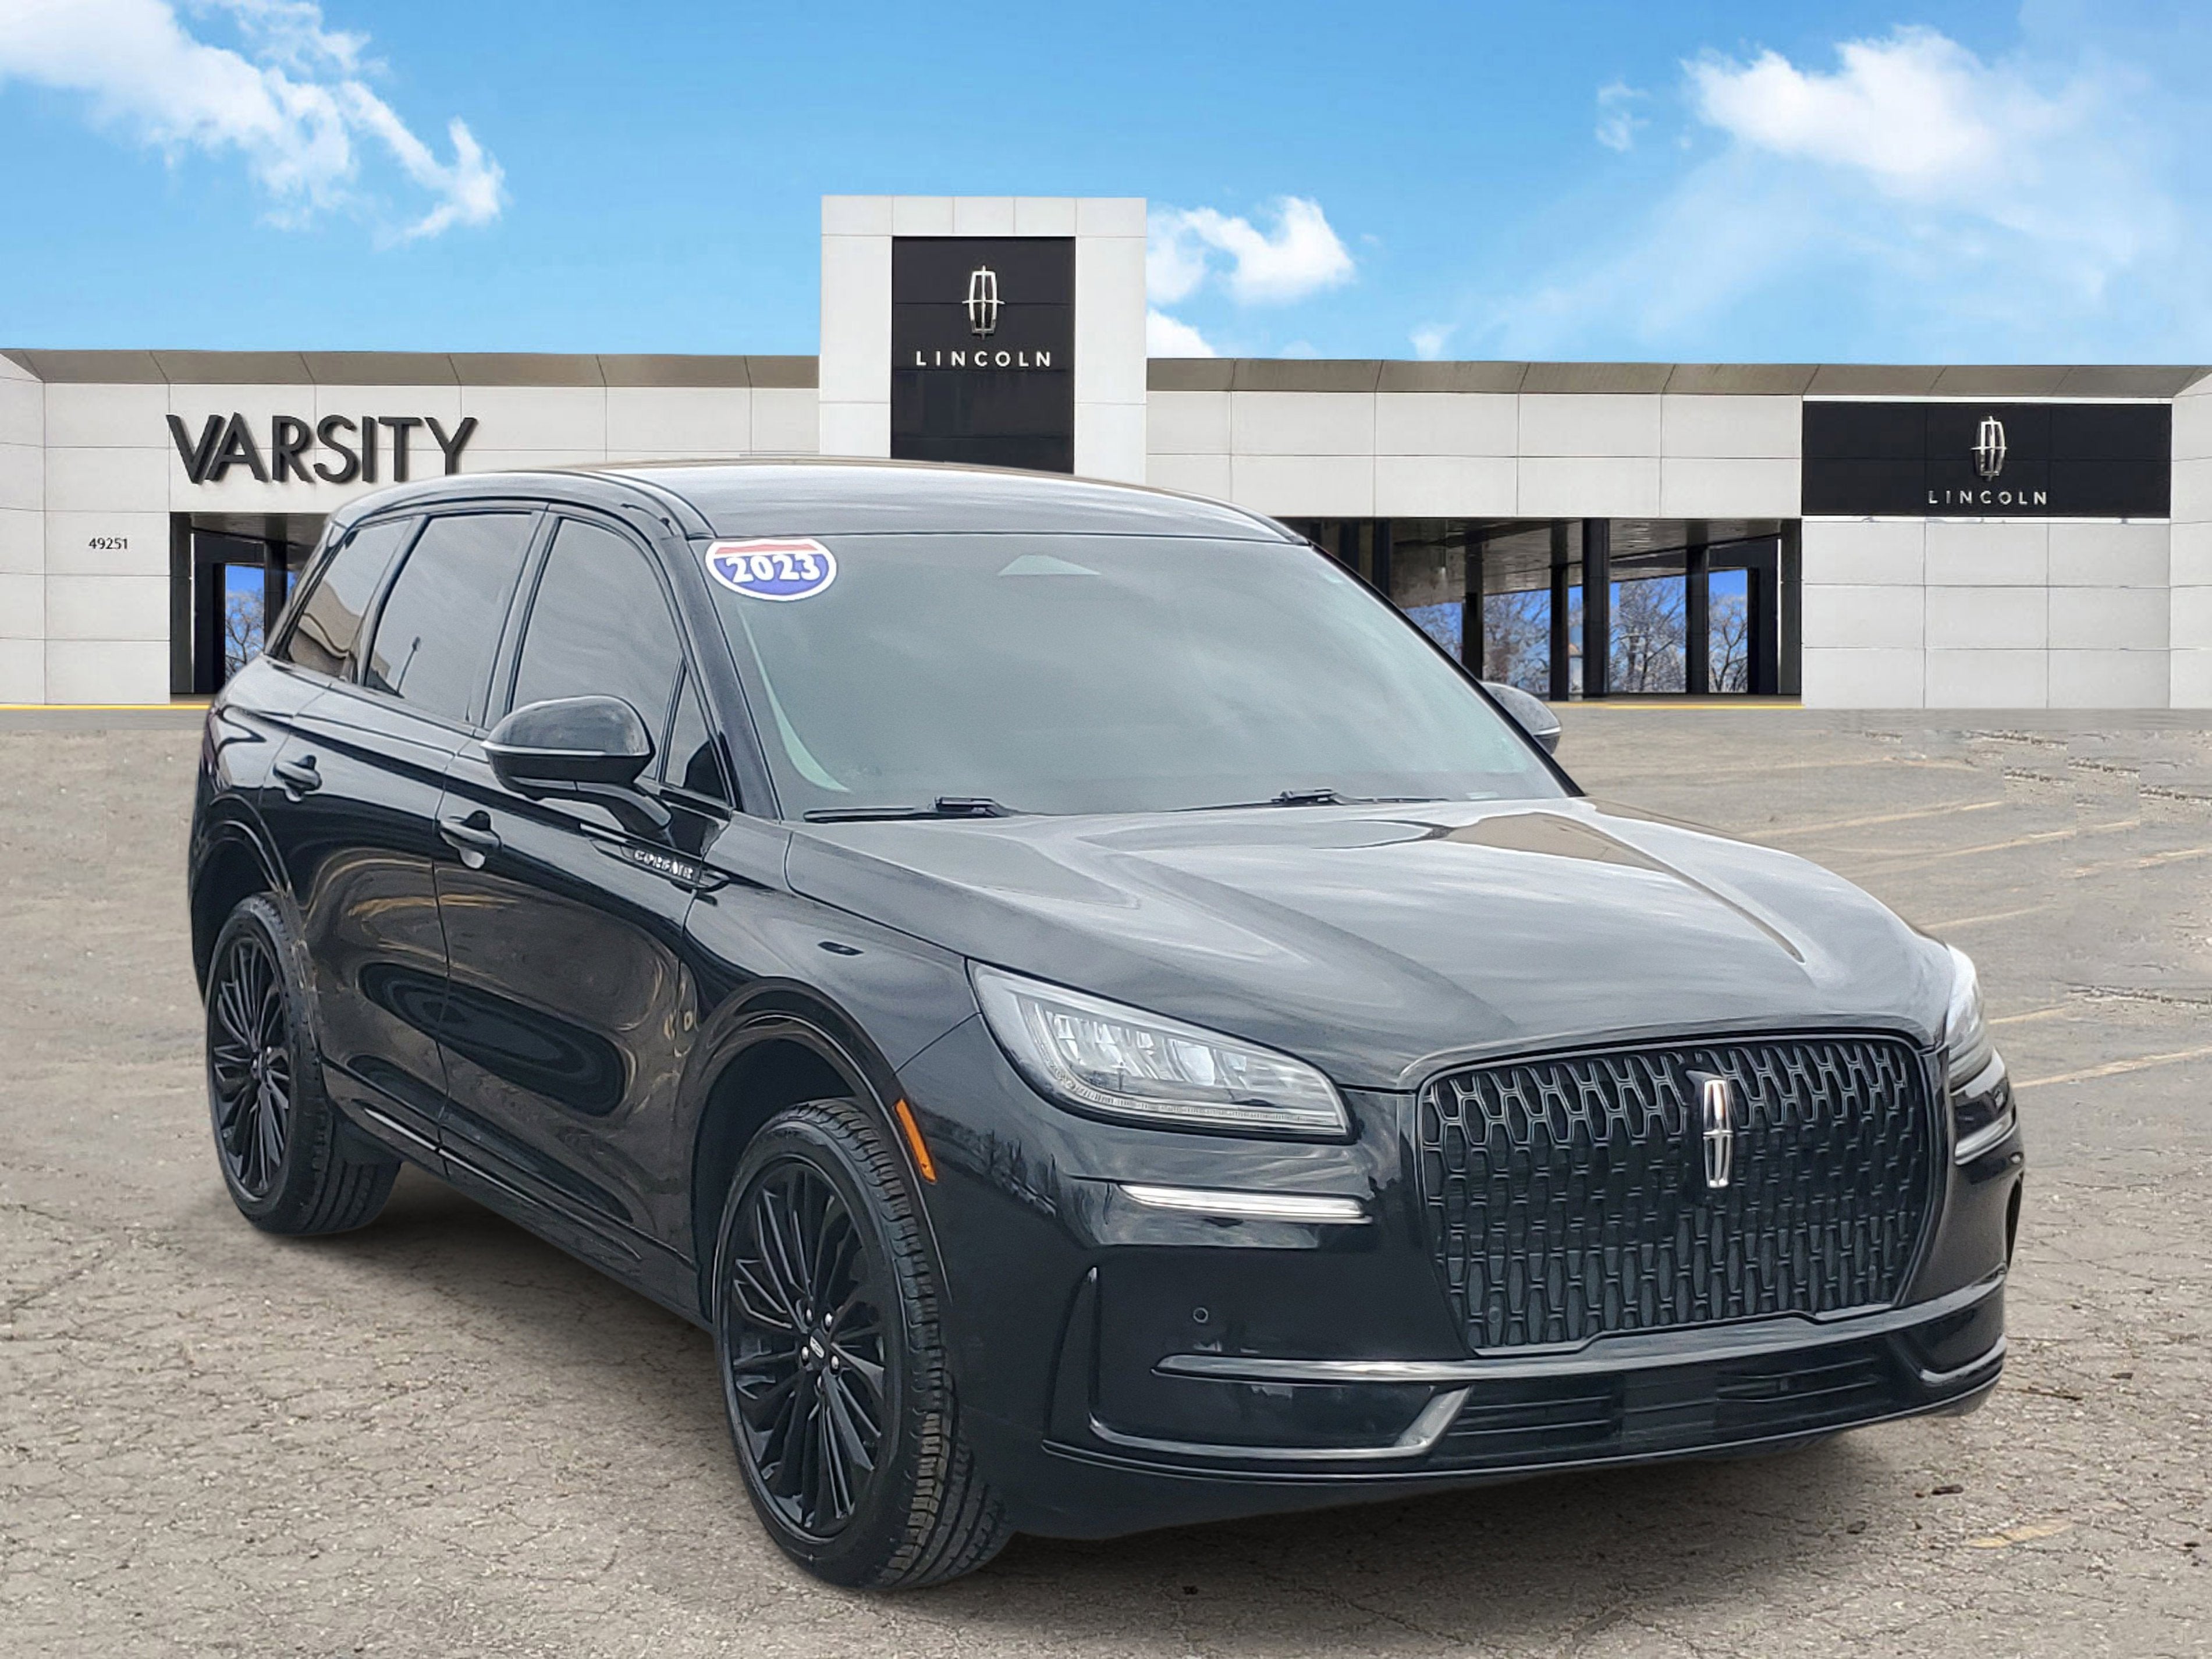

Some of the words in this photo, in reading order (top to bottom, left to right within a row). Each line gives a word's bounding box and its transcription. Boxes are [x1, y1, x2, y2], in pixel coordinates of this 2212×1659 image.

[915, 351, 1051, 367] LINCOLN
[165, 412, 478, 485] VARSITY
[1928, 490, 2047, 505] LINCOLN
[88, 537, 128, 550] 49251
[726, 553, 821, 582] 2023
